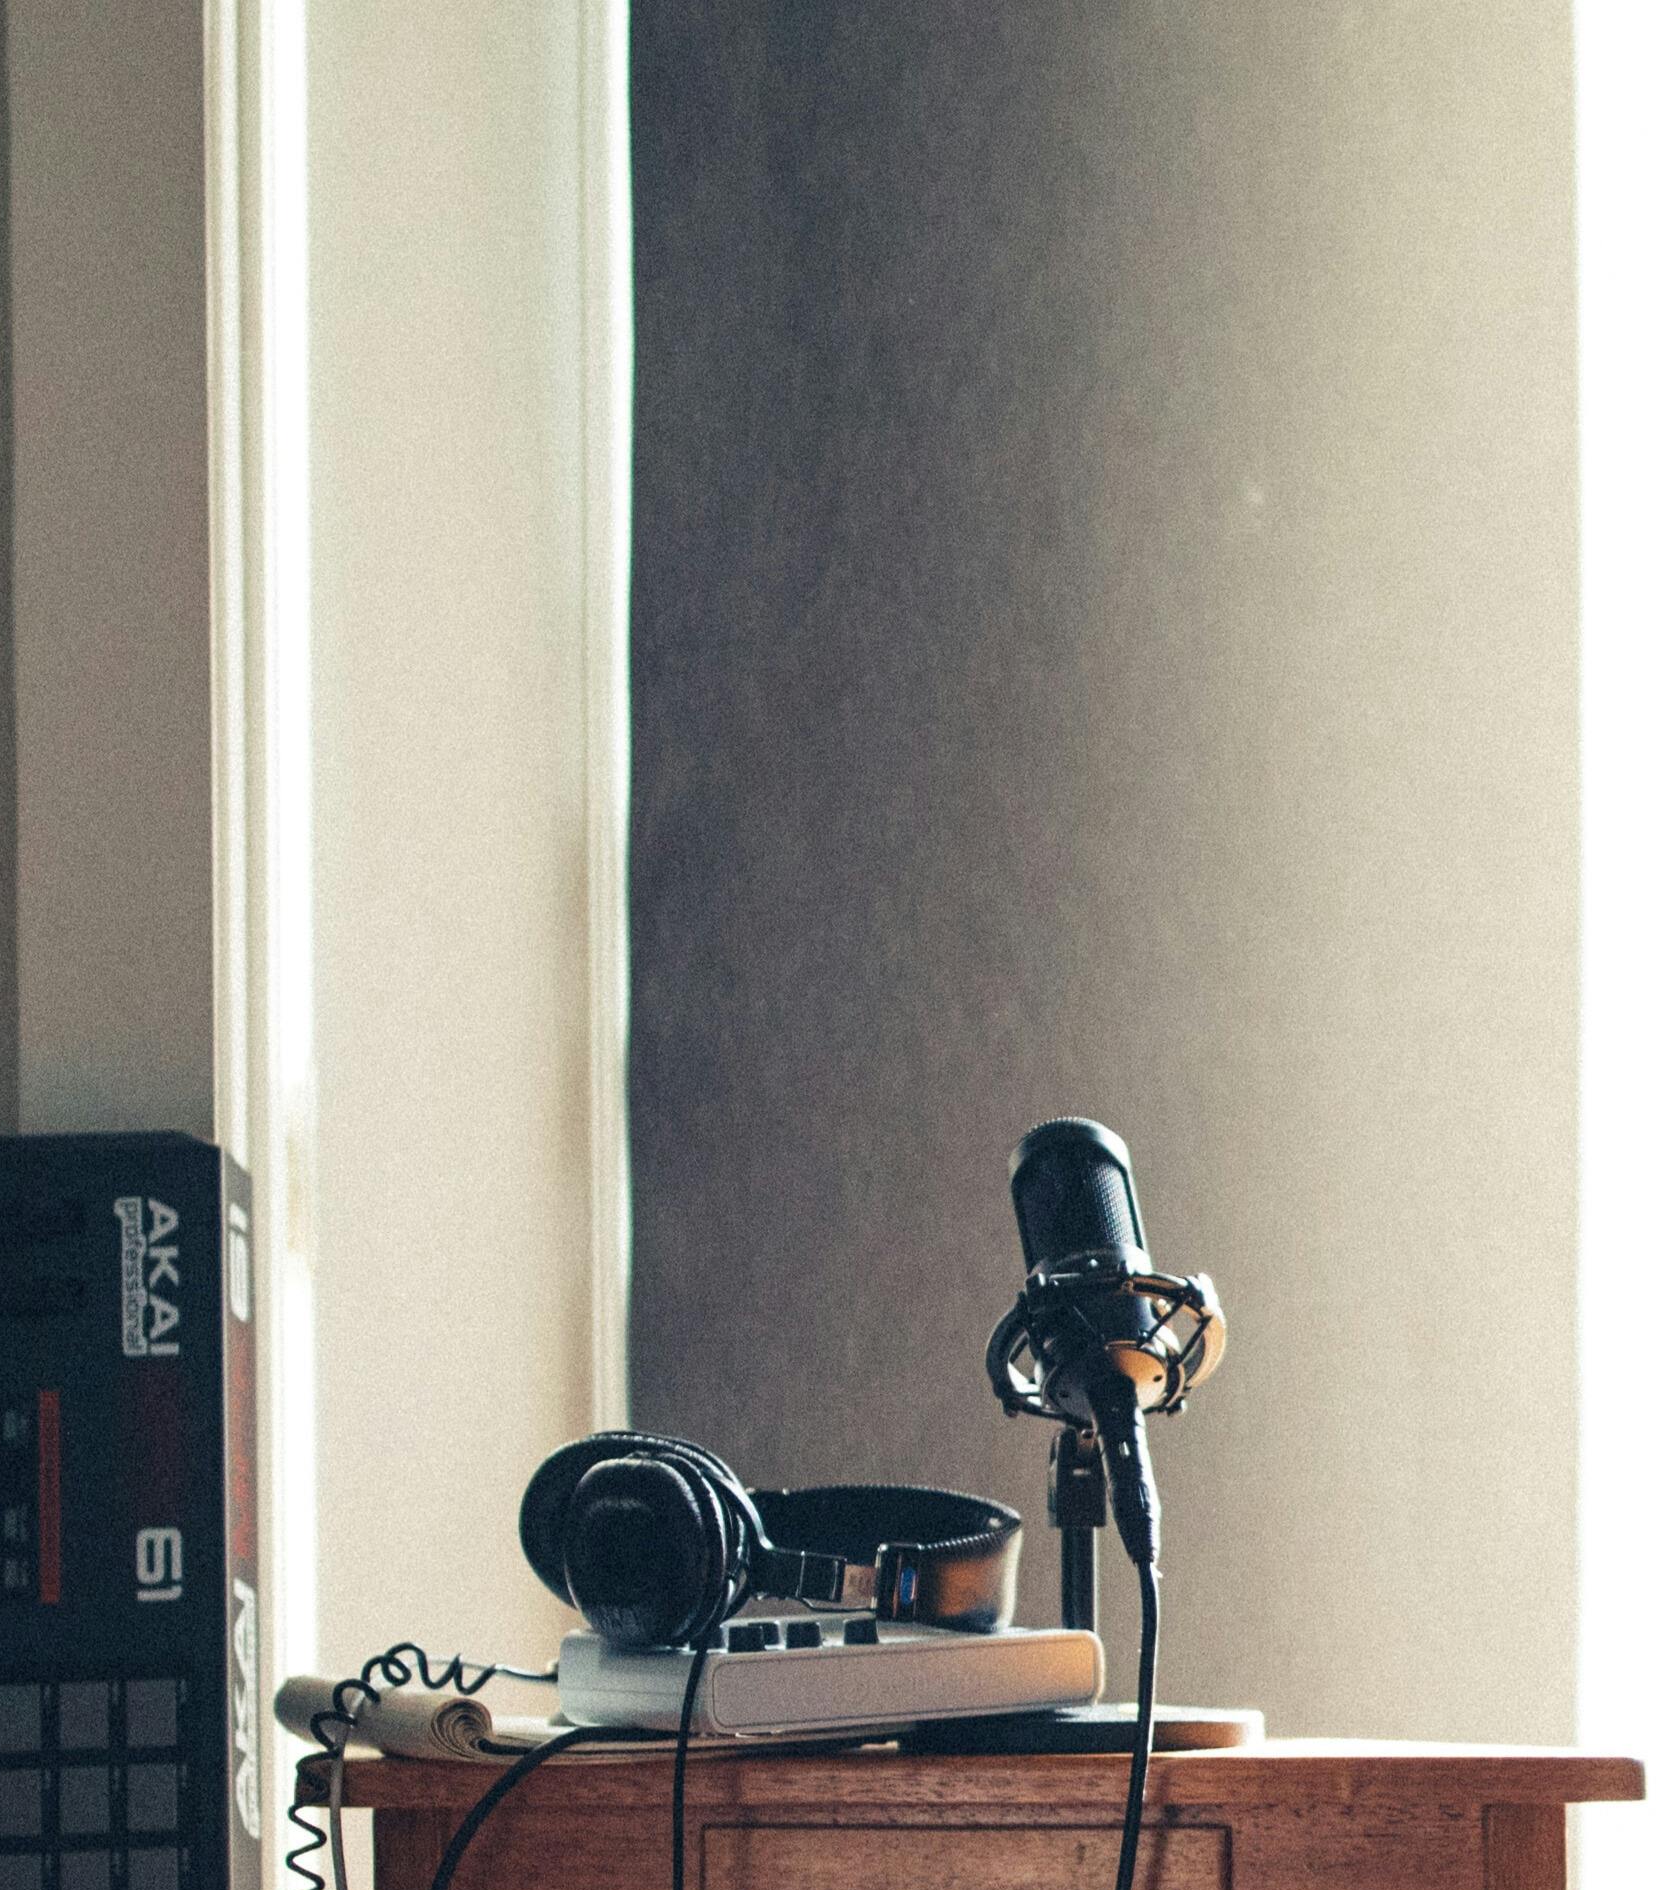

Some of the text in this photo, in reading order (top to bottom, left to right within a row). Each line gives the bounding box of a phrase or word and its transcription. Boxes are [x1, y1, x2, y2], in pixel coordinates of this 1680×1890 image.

[122, 1200, 146, 1351] professional
[147, 1197, 180, 1357] AKAI
[135, 1527, 184, 1603] 61
